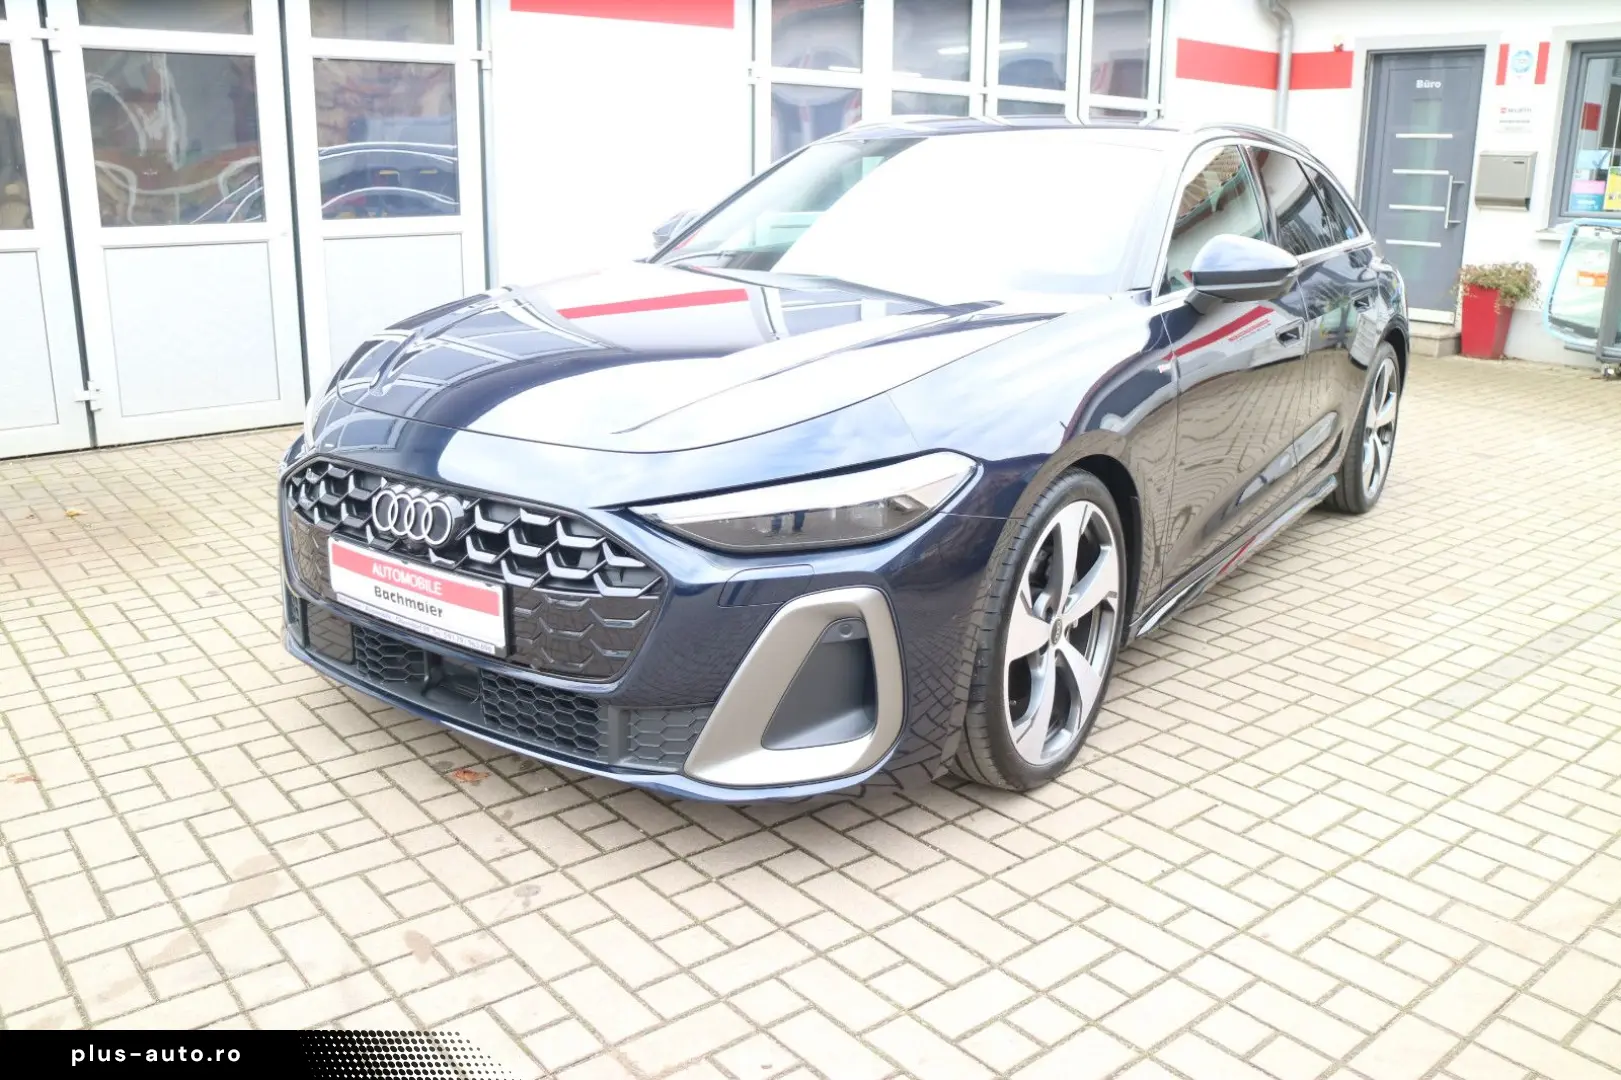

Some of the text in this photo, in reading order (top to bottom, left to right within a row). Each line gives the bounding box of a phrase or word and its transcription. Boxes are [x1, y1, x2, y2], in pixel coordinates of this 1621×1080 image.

[1416, 79, 1442, 89] Büro
[372, 562, 442, 595] AUTOMOBILE
[374, 585, 443, 618] Bachmaier
